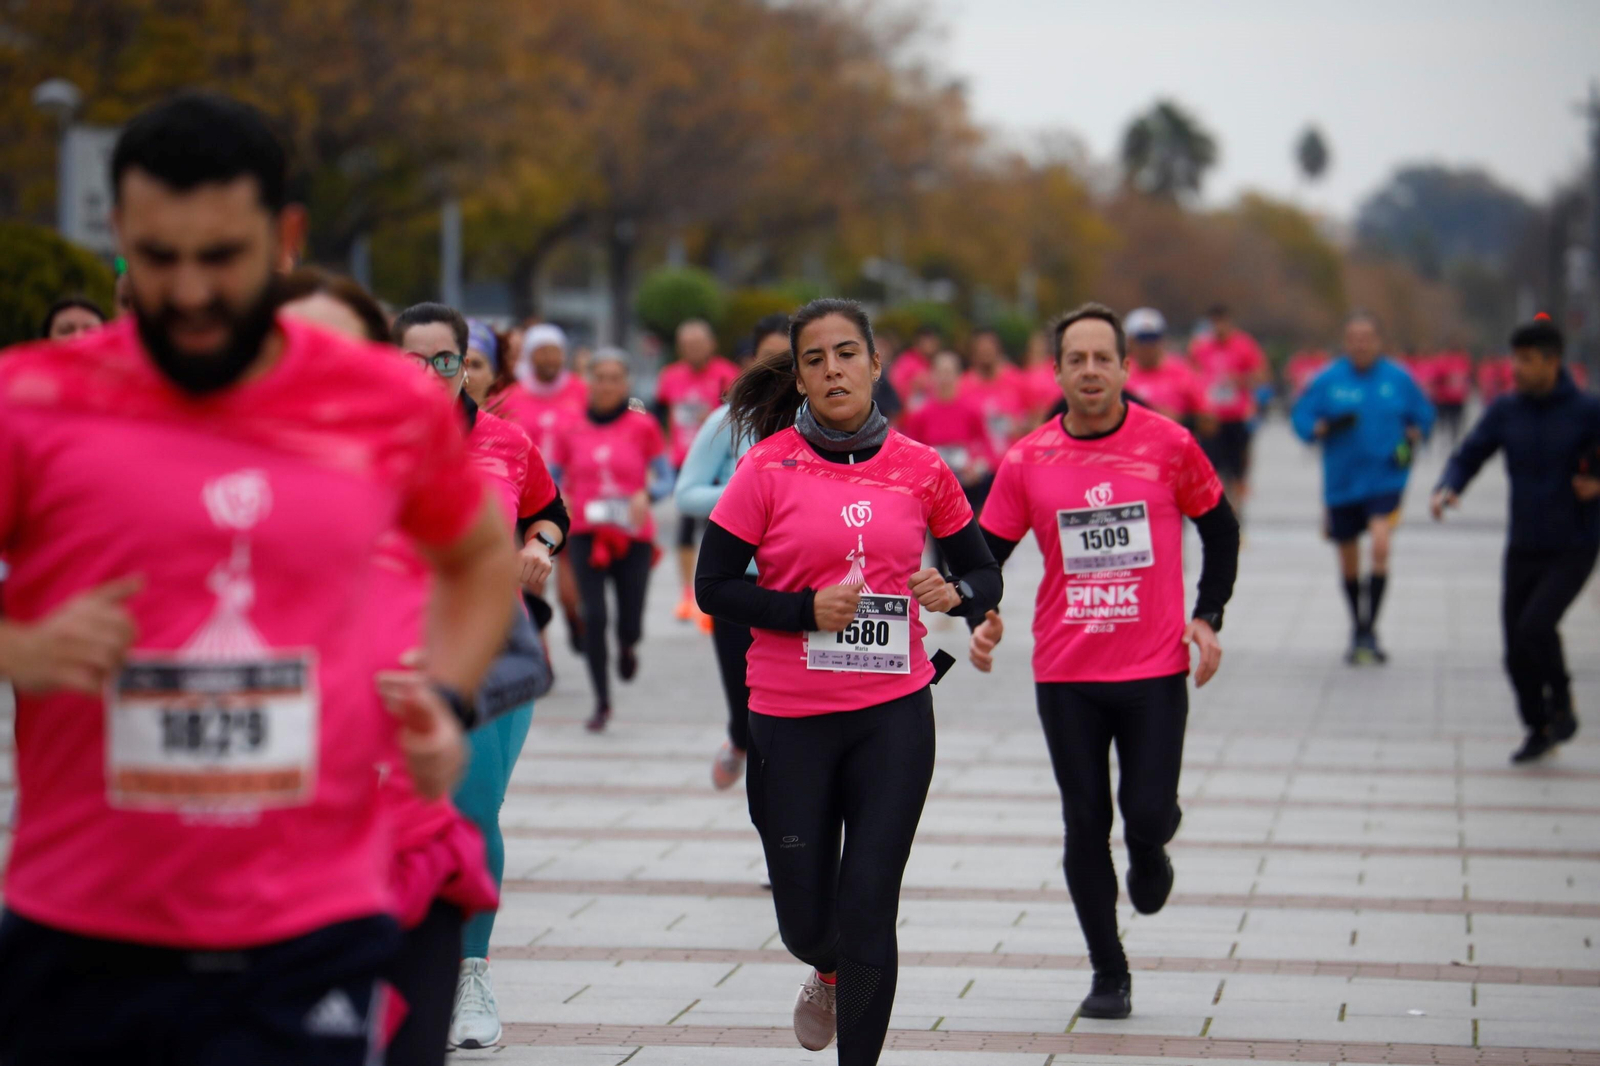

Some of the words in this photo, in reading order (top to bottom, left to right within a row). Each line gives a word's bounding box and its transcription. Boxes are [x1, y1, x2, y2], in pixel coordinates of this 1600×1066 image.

[1079, 526, 1129, 551] 1509
[1066, 584, 1139, 607] PINK
[1065, 605, 1139, 619] RUNNING
